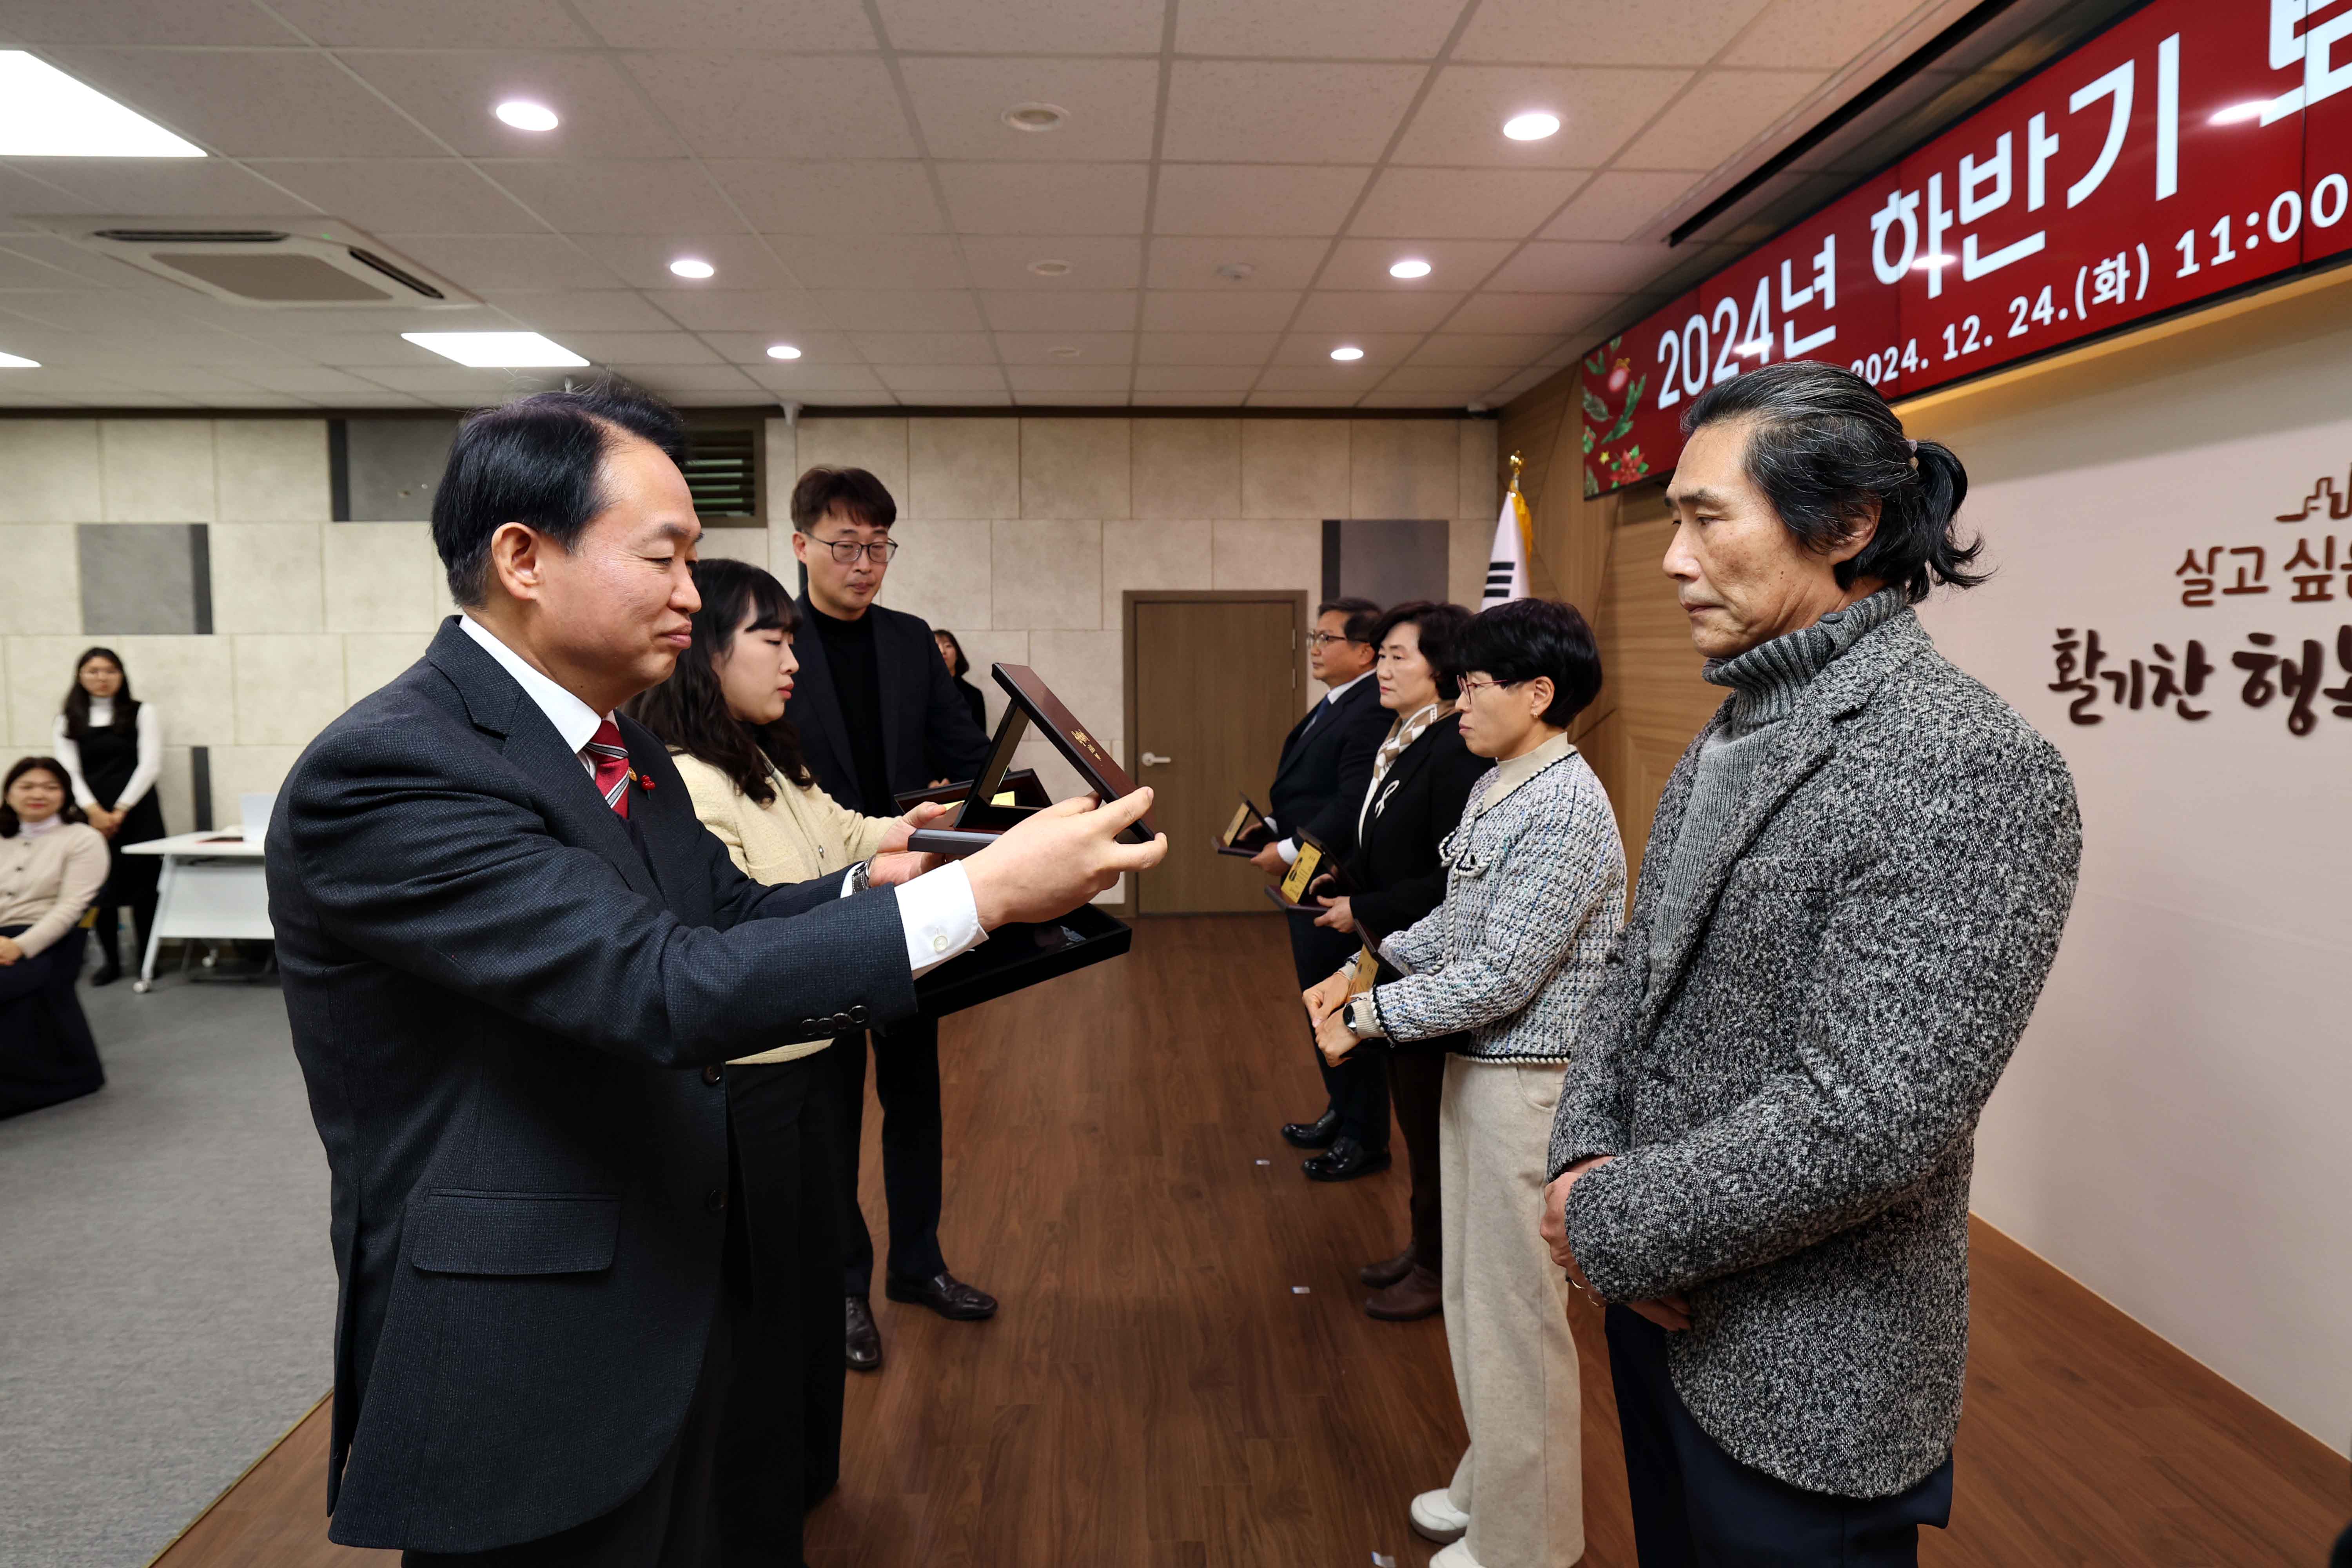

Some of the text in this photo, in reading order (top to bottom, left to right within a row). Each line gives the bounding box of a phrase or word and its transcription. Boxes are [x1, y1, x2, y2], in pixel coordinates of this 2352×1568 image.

[1657, 234, 1837, 410] 2024년
[1870, 32, 2180, 299] 하반기
[1942, 314, 1993, 361] 12.
[2008, 242, 2150, 339] 24.(화)
[2175, 173, 2349, 278] 11:00
[2175, 535, 2352, 608] 살고 싶
[2047, 627, 2216, 727] 활기찬
